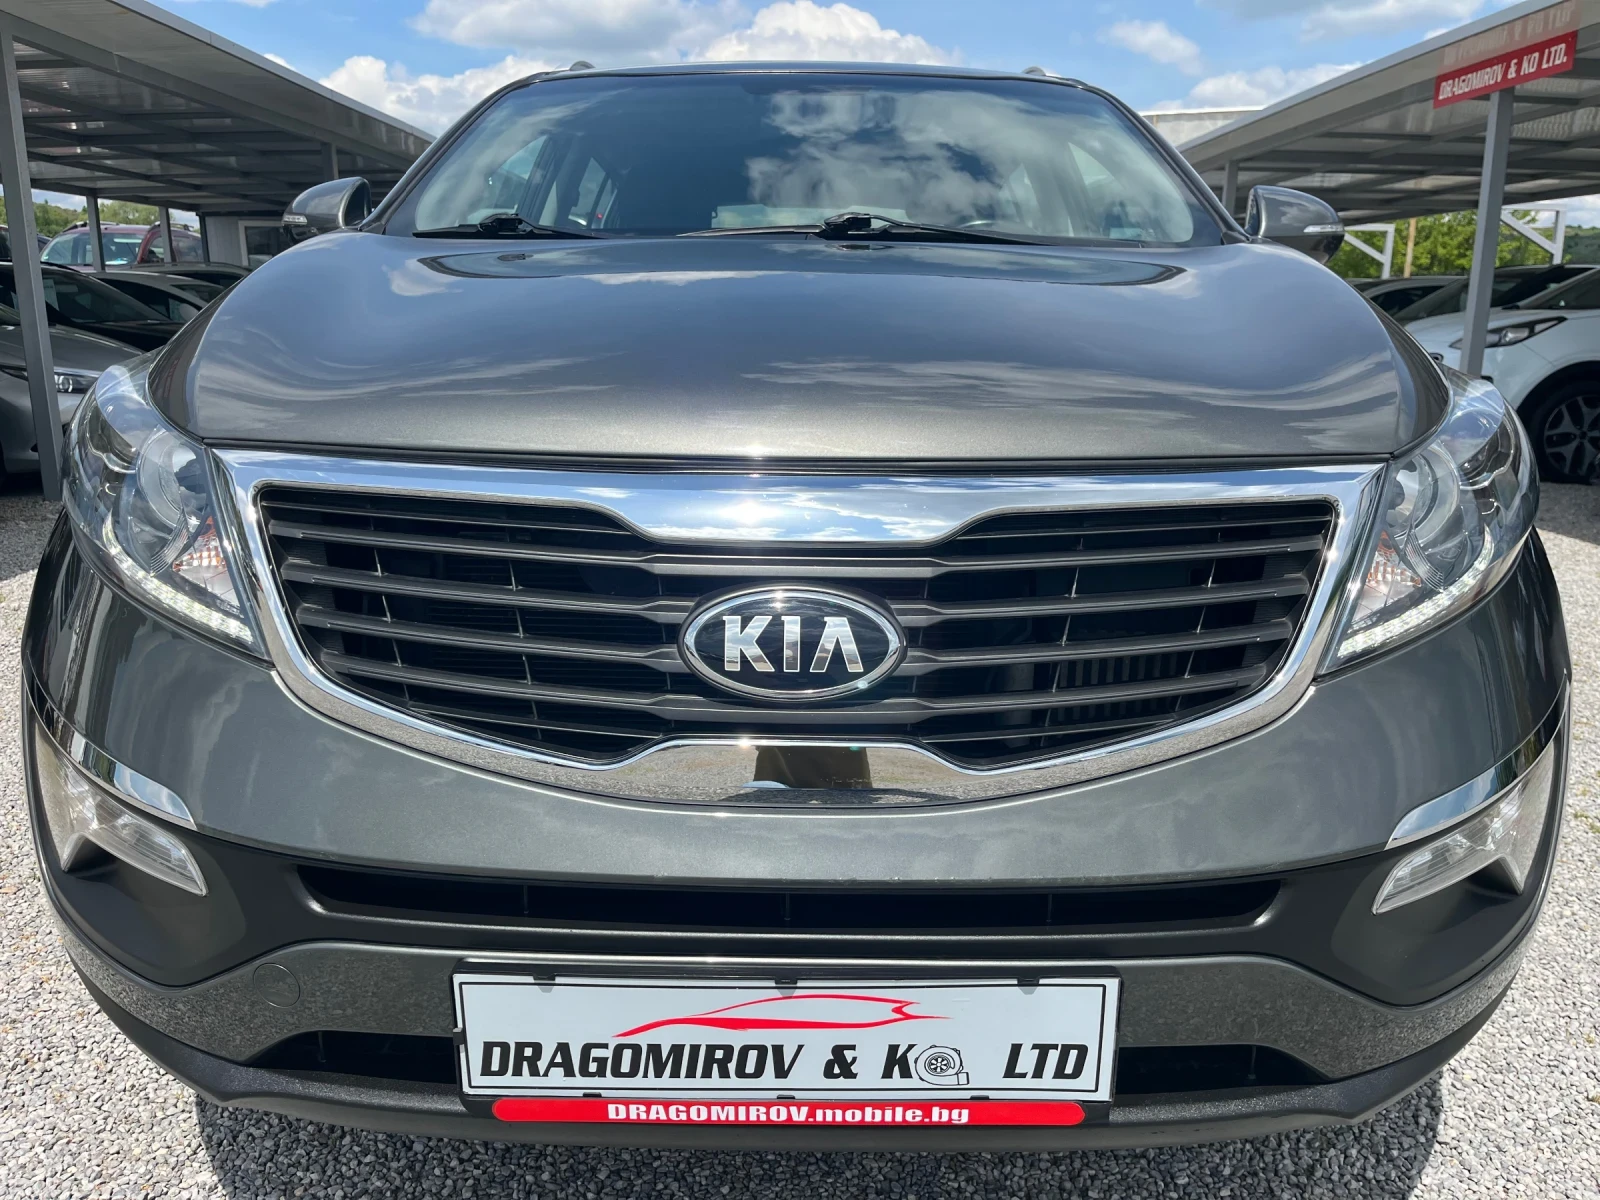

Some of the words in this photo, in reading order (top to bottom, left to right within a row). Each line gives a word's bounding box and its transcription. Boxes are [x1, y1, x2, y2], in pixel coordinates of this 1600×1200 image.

[1438, 63, 1507, 100] DRAGOMIROV
[1507, 59, 1518, 79] &
[1520, 52, 1539, 76] KO
[1541, 43, 1568, 70] LTD.
[722, 615, 864, 673] KIA
[480, 1040, 805, 1080] DRAGOMIROV
[822, 1044, 859, 1080] &
[1002, 1042, 1089, 1080] LTD
[607, 1102, 970, 1125] DRAGOMIROV.mobile.bg
